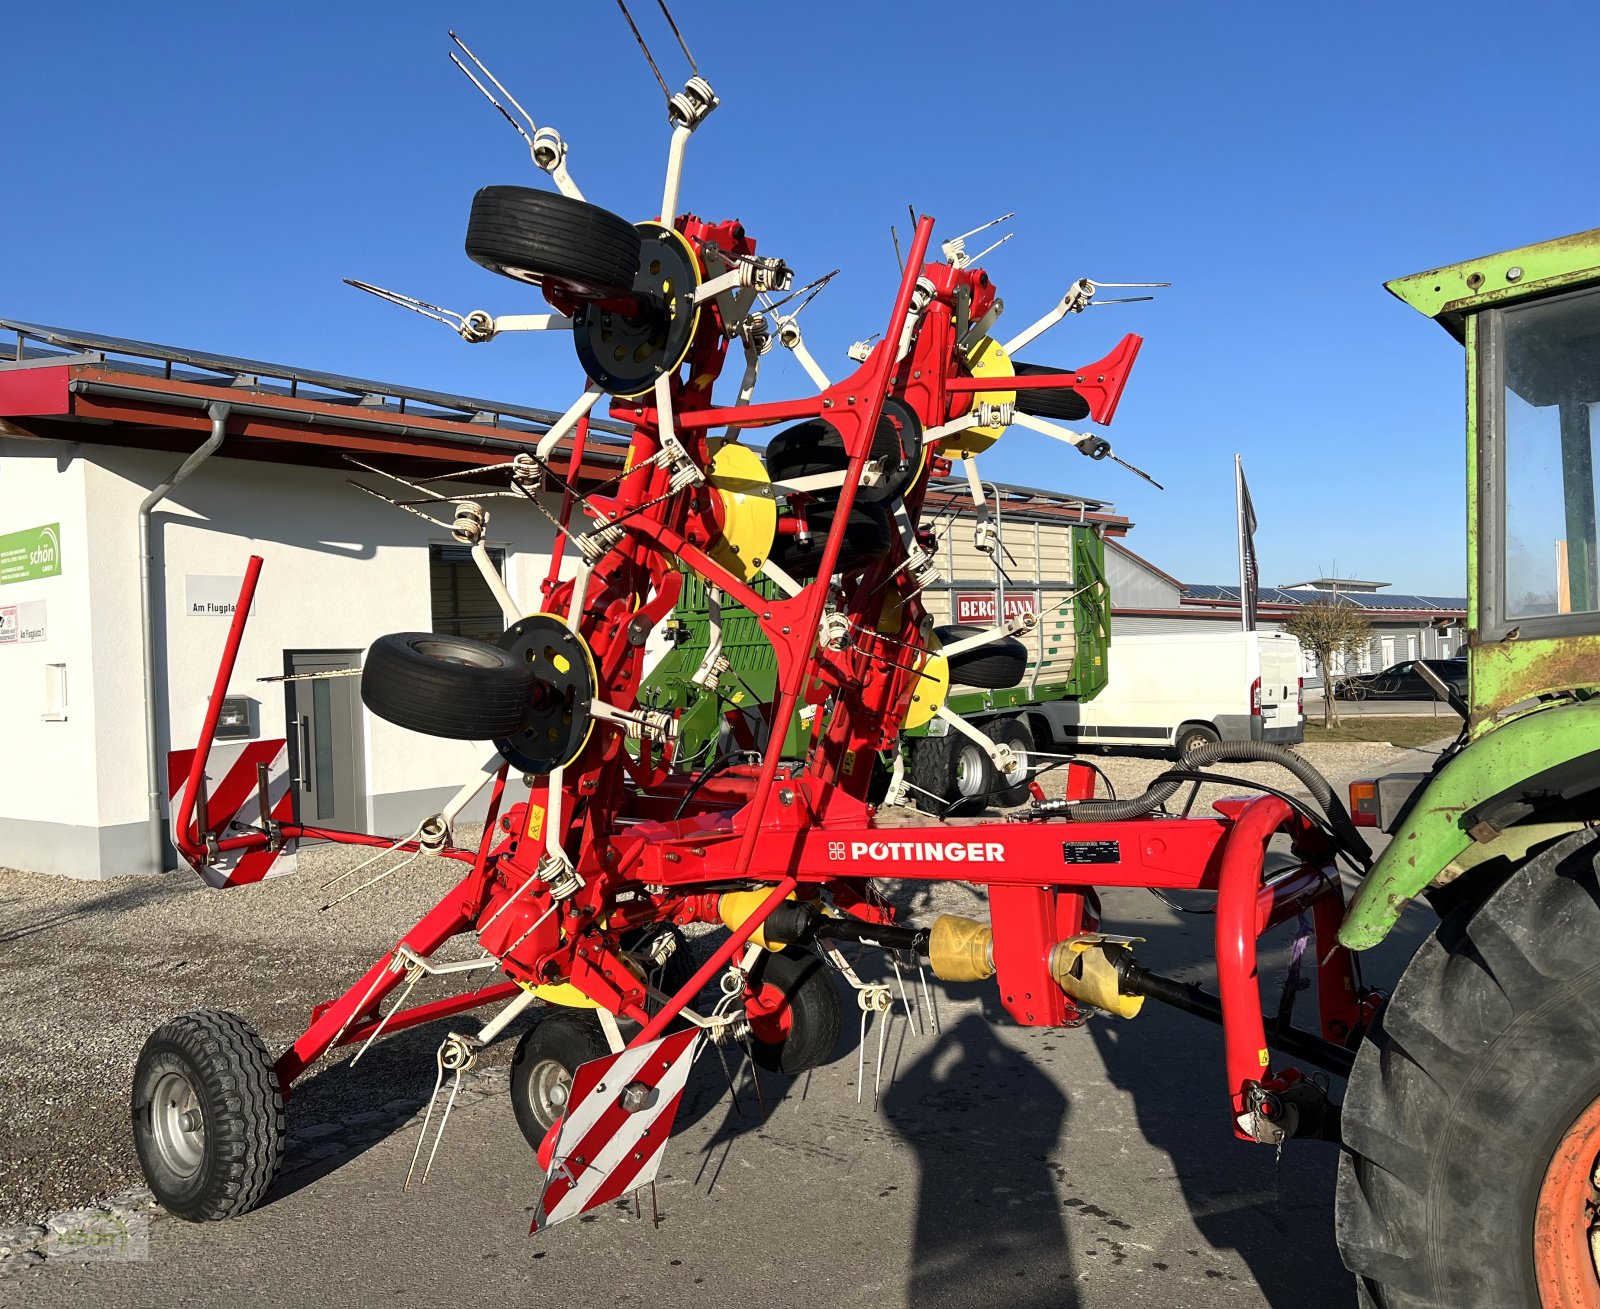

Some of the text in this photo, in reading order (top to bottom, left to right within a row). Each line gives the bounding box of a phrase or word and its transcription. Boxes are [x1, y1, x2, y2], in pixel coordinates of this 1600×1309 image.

[30, 544, 54, 565] schön
[192, 602, 238, 614] Am Flugpla
[851, 842, 1005, 862] PÖTTINGER
